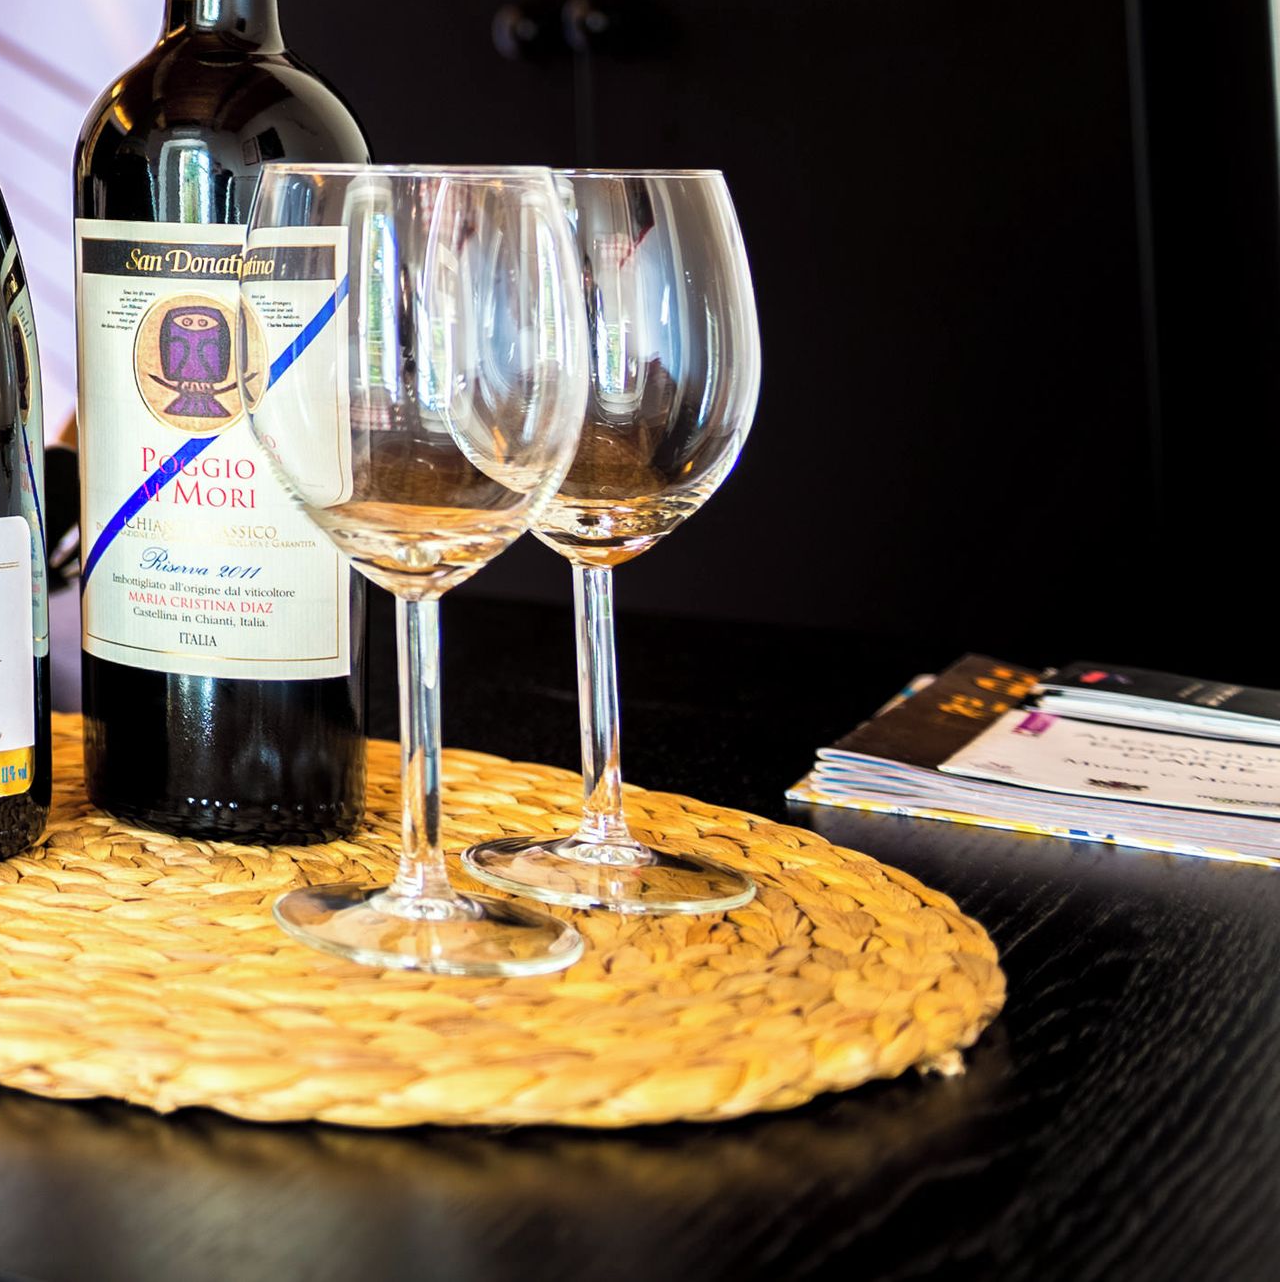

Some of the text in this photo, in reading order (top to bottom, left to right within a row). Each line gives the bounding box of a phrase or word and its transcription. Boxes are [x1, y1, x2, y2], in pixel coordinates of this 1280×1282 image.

[126, 248, 162, 271] San
[141, 446, 255, 480] POGGIO
[173, 479, 256, 509] MORI
[139, 546, 262, 579] Riserva 2011
[112, 572, 296, 598] Imbottigliato all'origine dal viticoltore
[128, 590, 273, 614] MARIA CRISTINA DIAZ
[133, 606, 178, 621] Castellina
[181, 612, 192, 623] in
[195, 614, 236, 628] Chianti,
[179, 631, 217, 647] ITALIA
